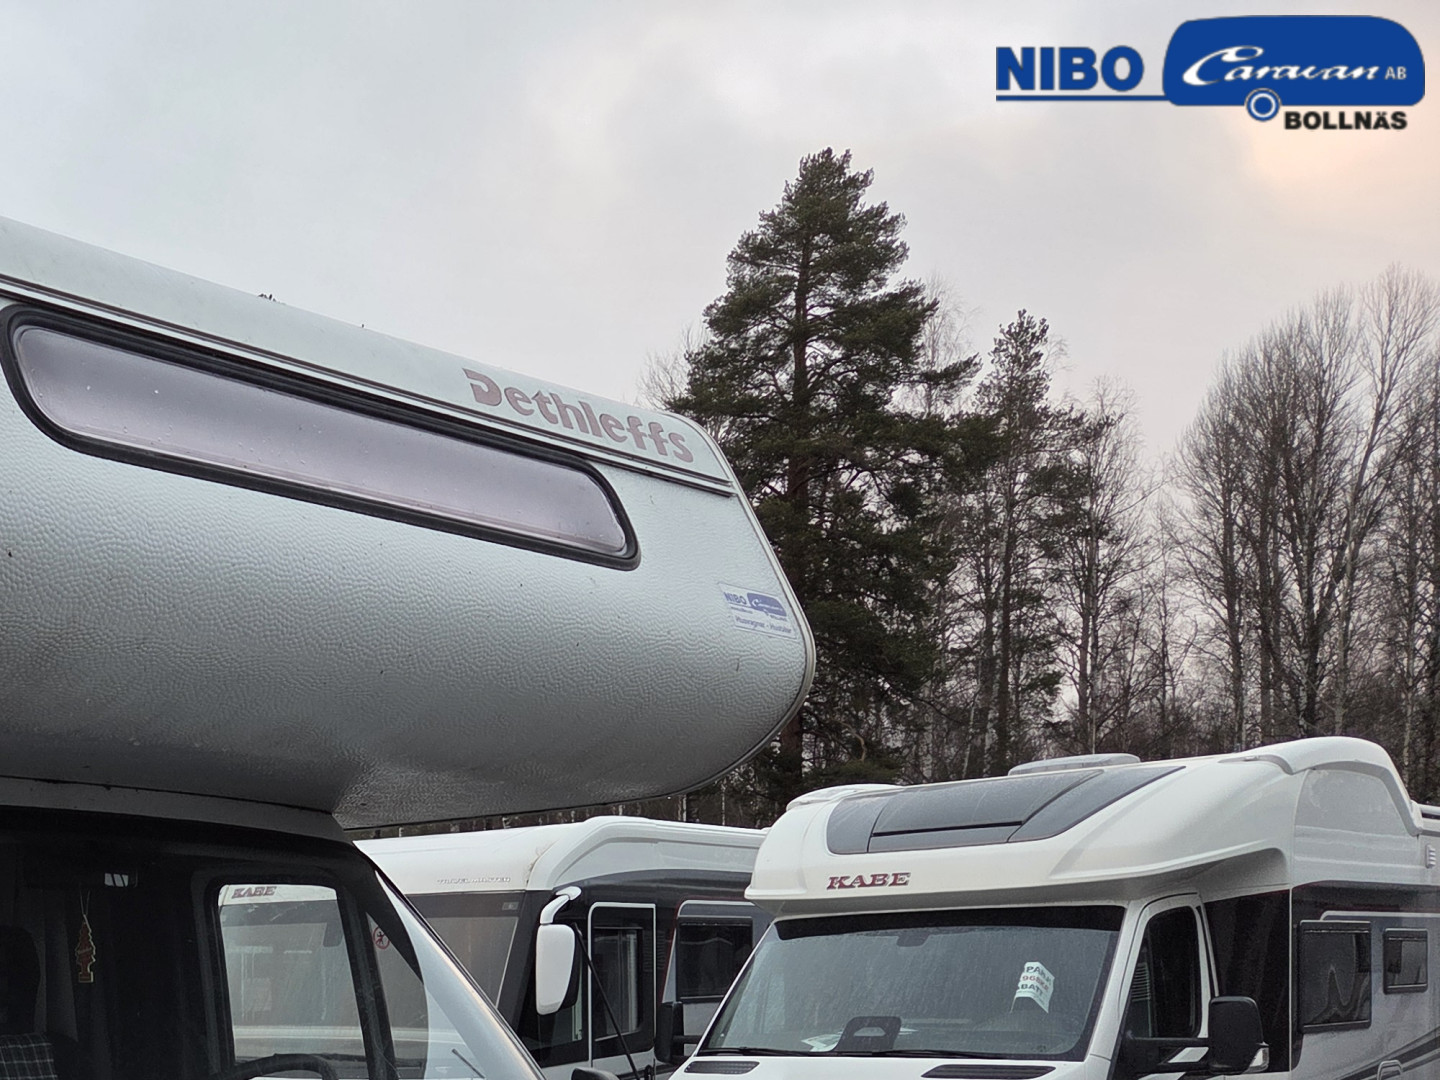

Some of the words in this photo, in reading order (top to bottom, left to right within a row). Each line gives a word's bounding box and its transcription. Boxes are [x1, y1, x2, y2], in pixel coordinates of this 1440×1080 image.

[462, 368, 694, 463] Dethleffs
[826, 872, 911, 890] KABE
[231, 886, 277, 899] KABE
